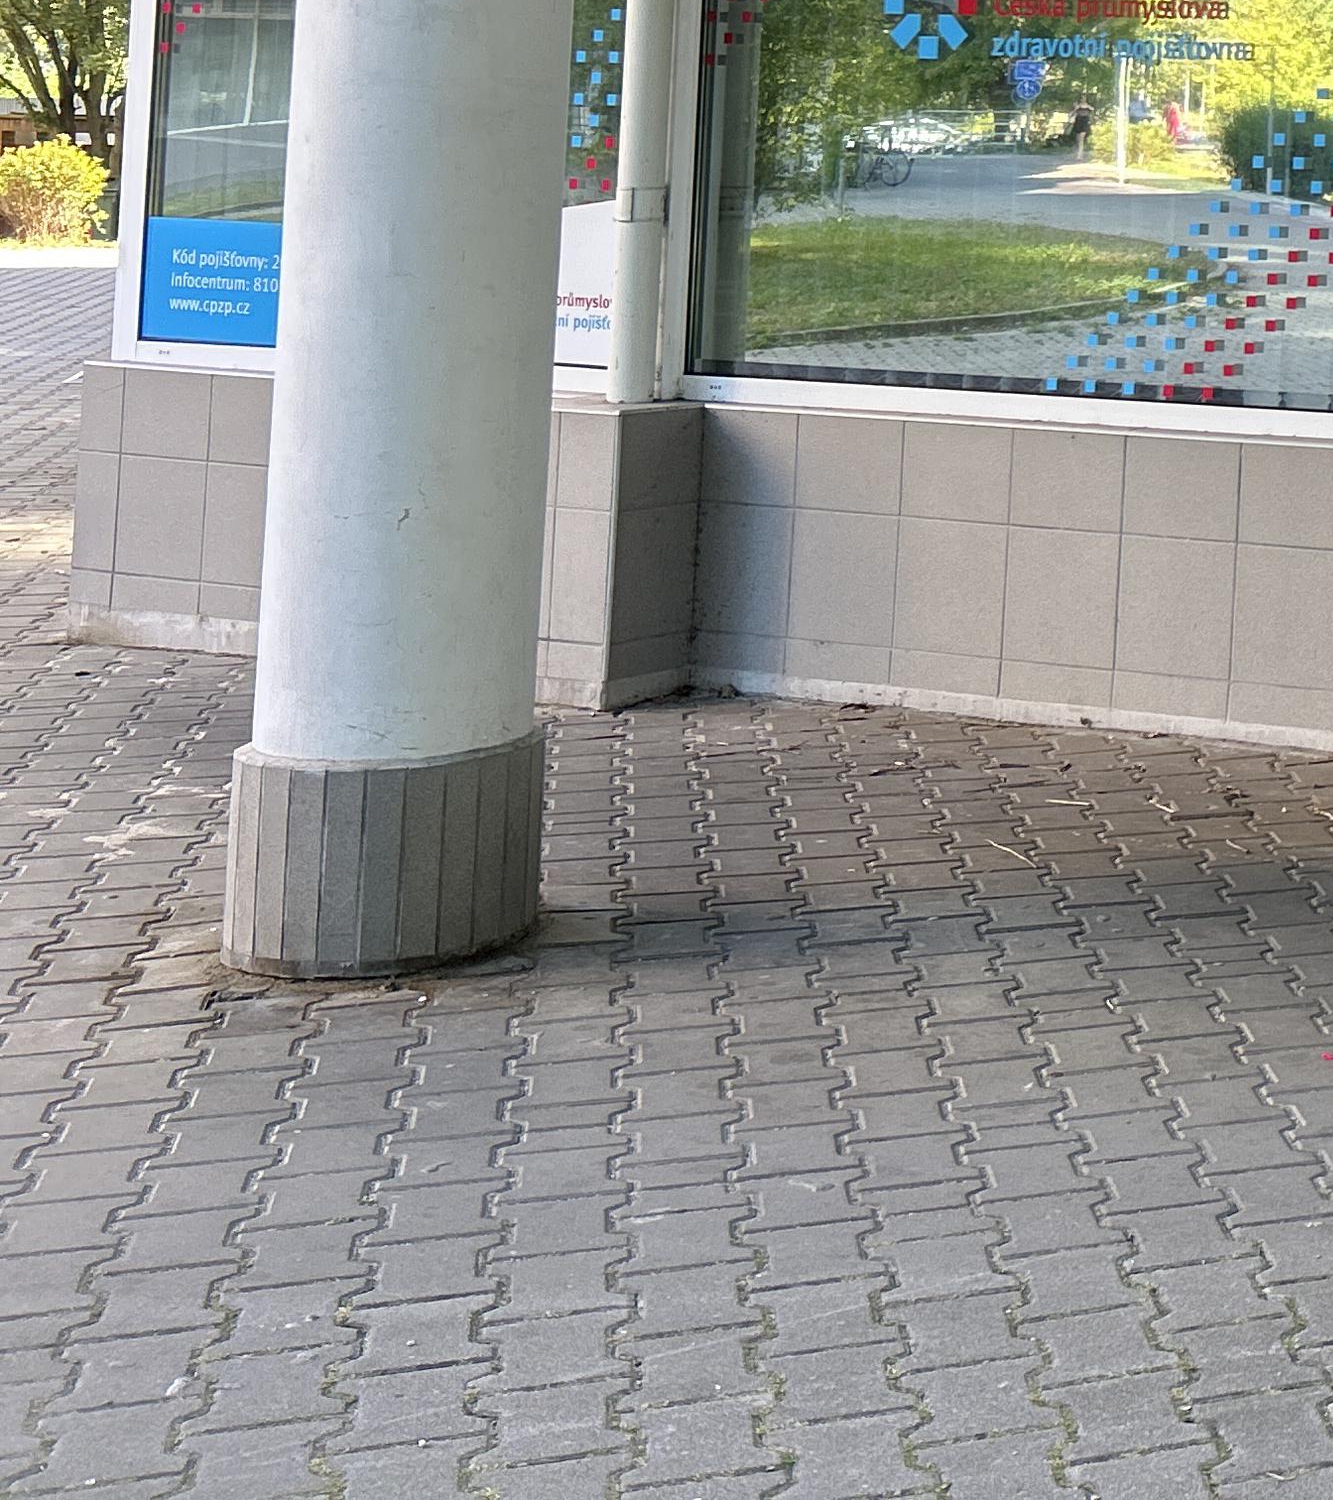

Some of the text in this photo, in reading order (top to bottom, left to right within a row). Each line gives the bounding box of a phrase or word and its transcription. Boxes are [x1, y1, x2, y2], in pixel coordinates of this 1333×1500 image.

[991, 30, 1108, 59] zdravotní
[172, 248, 196, 265] Kód
[199, 250, 268, 271] pojišťovny:
[171, 272, 279, 293] Infocentrum: 810
[169, 298, 250, 317] www.cpzp.cz
